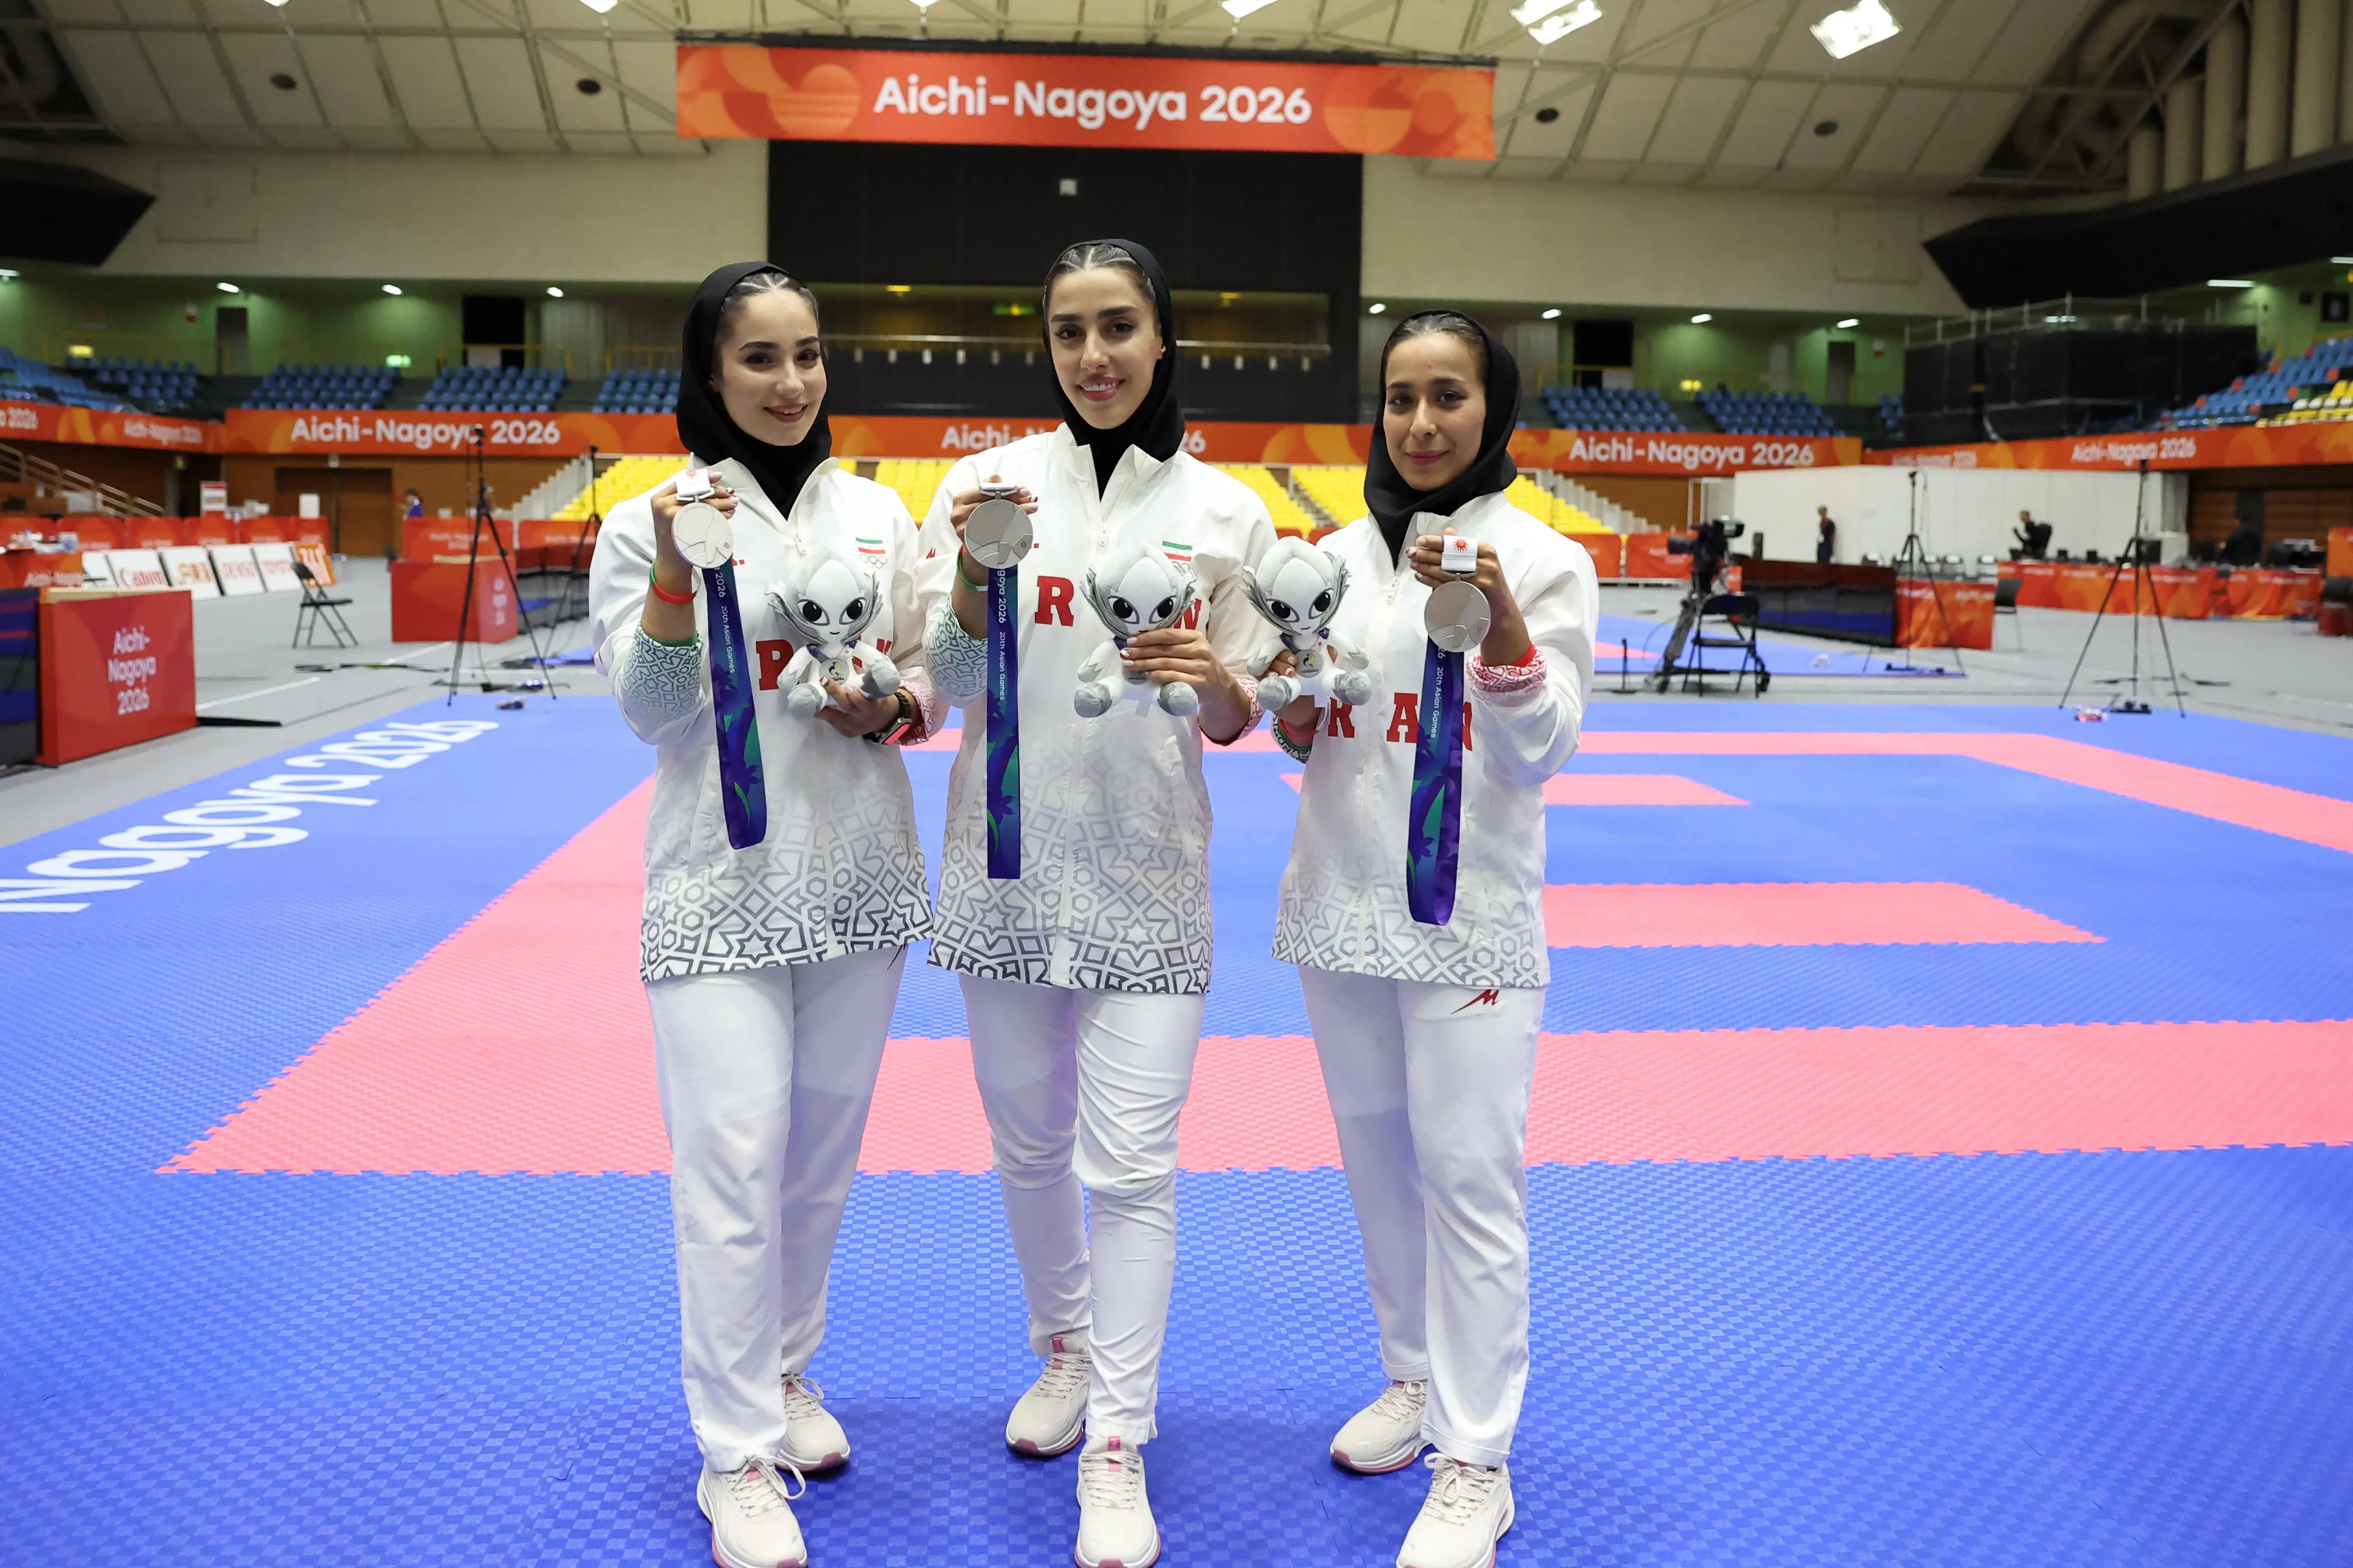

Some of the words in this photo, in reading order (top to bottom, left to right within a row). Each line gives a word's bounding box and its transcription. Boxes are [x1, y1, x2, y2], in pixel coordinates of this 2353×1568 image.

[874, 74, 1187, 131] Aichi-Nagoya
[1200, 85, 1312, 124] 2026
[489, 420, 561, 444] 2026
[1569, 436, 1745, 471] Aichi-Nagoya
[1751, 442, 1815, 466] 2026
[2159, 435, 2197, 459] 2026
[715, 572, 726, 598] 2026
[997, 570, 1006, 595] goya
[999, 598, 1007, 624] 2026
[113, 626, 150, 654] Aichi-
[1438, 646, 1446, 659] 26
[107, 656, 157, 687] Nagoya
[727, 646, 735, 674] Games
[117, 687, 150, 716] 2026
[1434, 687, 1442, 709] Asian
[1431, 710, 1440, 739] Games
[284, 720, 500, 768] 2026
